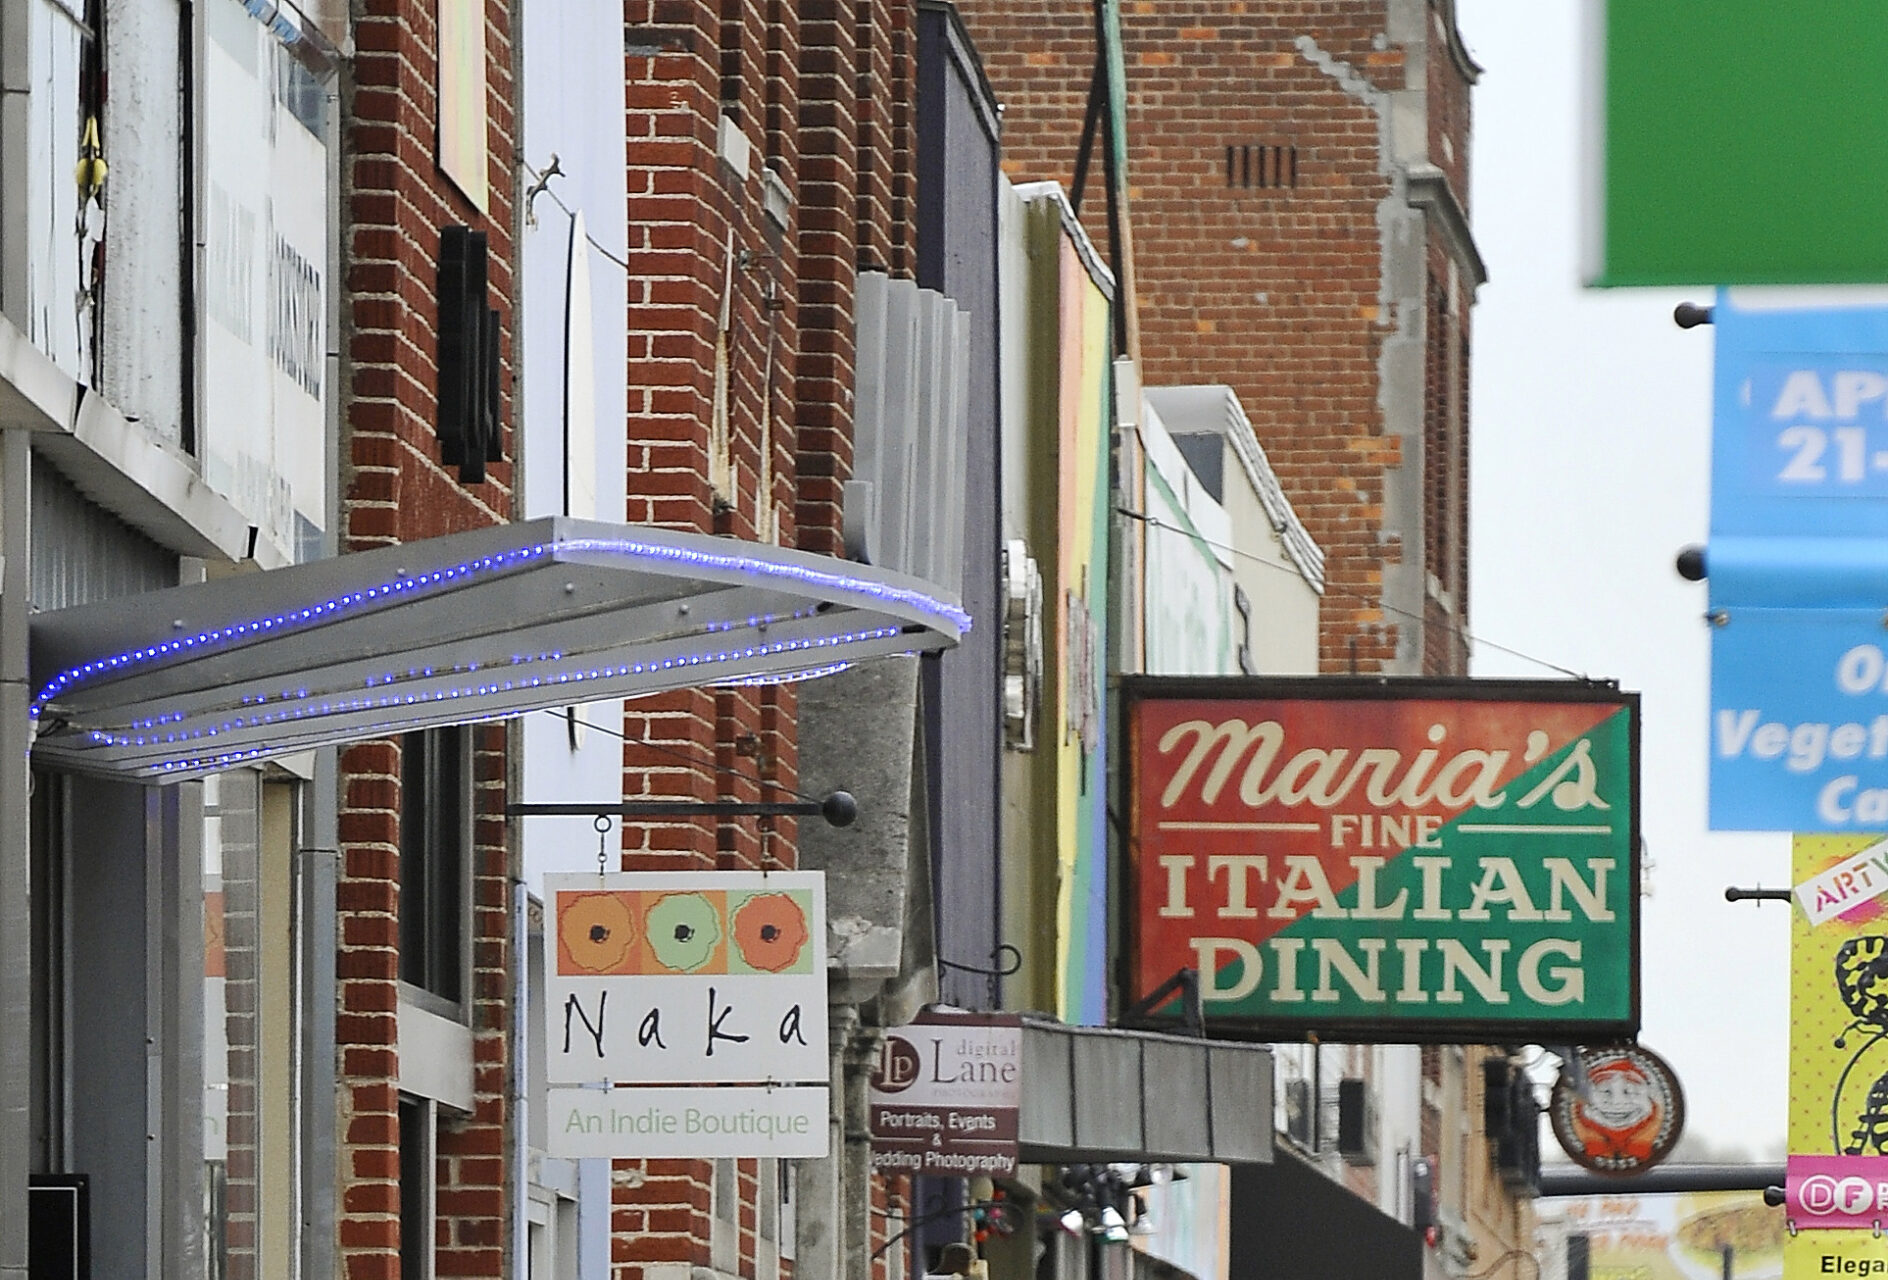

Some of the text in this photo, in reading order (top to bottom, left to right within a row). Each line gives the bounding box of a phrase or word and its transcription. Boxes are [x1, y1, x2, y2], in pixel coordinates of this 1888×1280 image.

[1771, 370, 1888, 419] AP
[1838, 644, 1888, 694] O
[1158, 718, 1611, 811] Maria's
[1331, 815, 1442, 848] FINE
[1158, 855, 1616, 922] ITALIAN
[1189, 936, 1585, 1004] DINING
[563, 987, 808, 1058] Naka
[930, 1038, 1016, 1084] Lane
[957, 1040, 1016, 1057] digital
[565, 1107, 809, 1140] An Indie Boutique
[880, 1111, 996, 1132] Portraits, Events
[932, 1133, 943, 1147] &
[871, 1150, 1015, 1172] edding Photography
[1821, 1256, 1888, 1277] Elega
